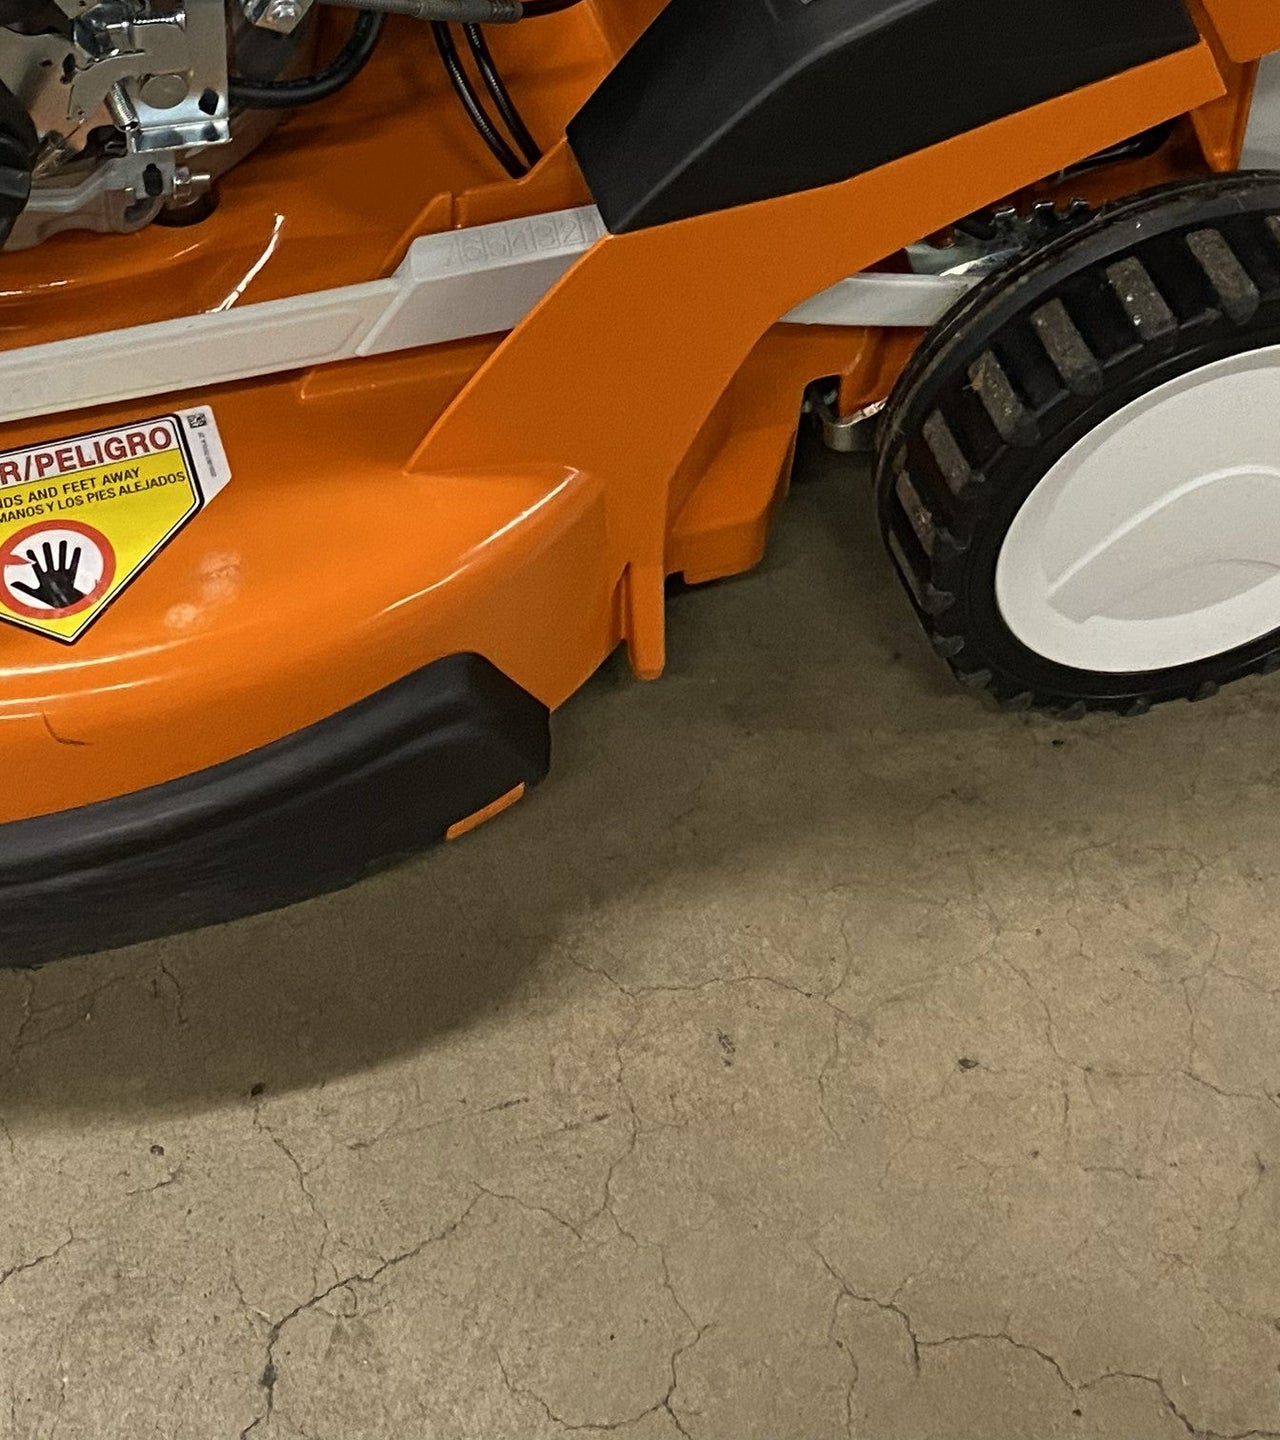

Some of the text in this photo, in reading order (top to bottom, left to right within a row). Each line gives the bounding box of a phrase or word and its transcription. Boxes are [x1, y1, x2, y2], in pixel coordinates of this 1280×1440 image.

[28, 487, 58, 504] AND
[63, 478, 96, 496] FEET
[102, 468, 141, 486] AWAY
[47, 502, 56, 514] Y
[58, 495, 84, 510] LOS
[87, 487, 116, 504] PIES
[119, 471, 186, 496] ALEJADOS
